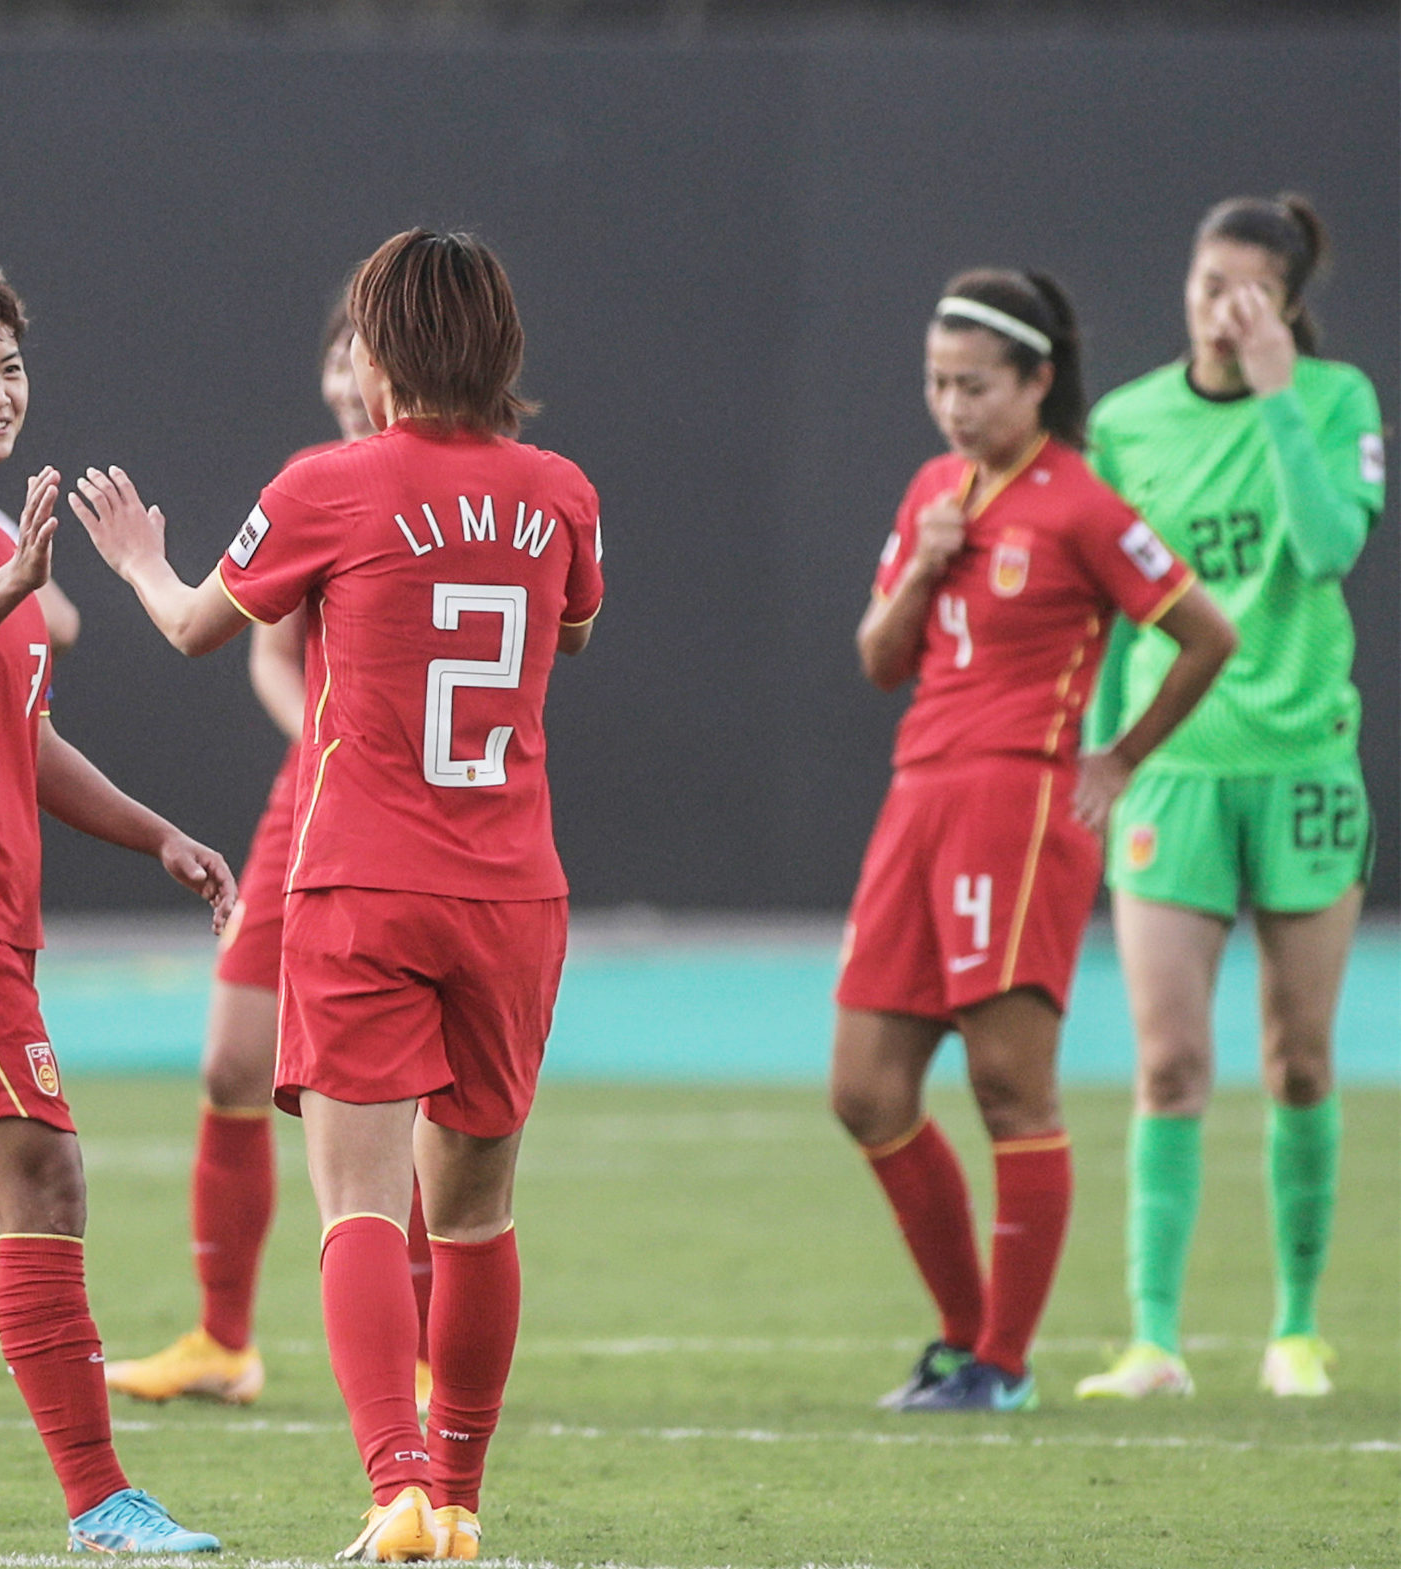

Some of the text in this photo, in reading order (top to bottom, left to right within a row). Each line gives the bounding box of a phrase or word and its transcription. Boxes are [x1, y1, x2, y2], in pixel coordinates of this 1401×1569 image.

[394, 495, 557, 558] LI M W
[1190, 511, 1263, 581] 22
[939, 593, 973, 669] 4
[25, 643, 47, 718] 7
[423, 582, 528, 787] 2
[1293, 783, 1358, 850] 22
[953, 873, 992, 949] 4
